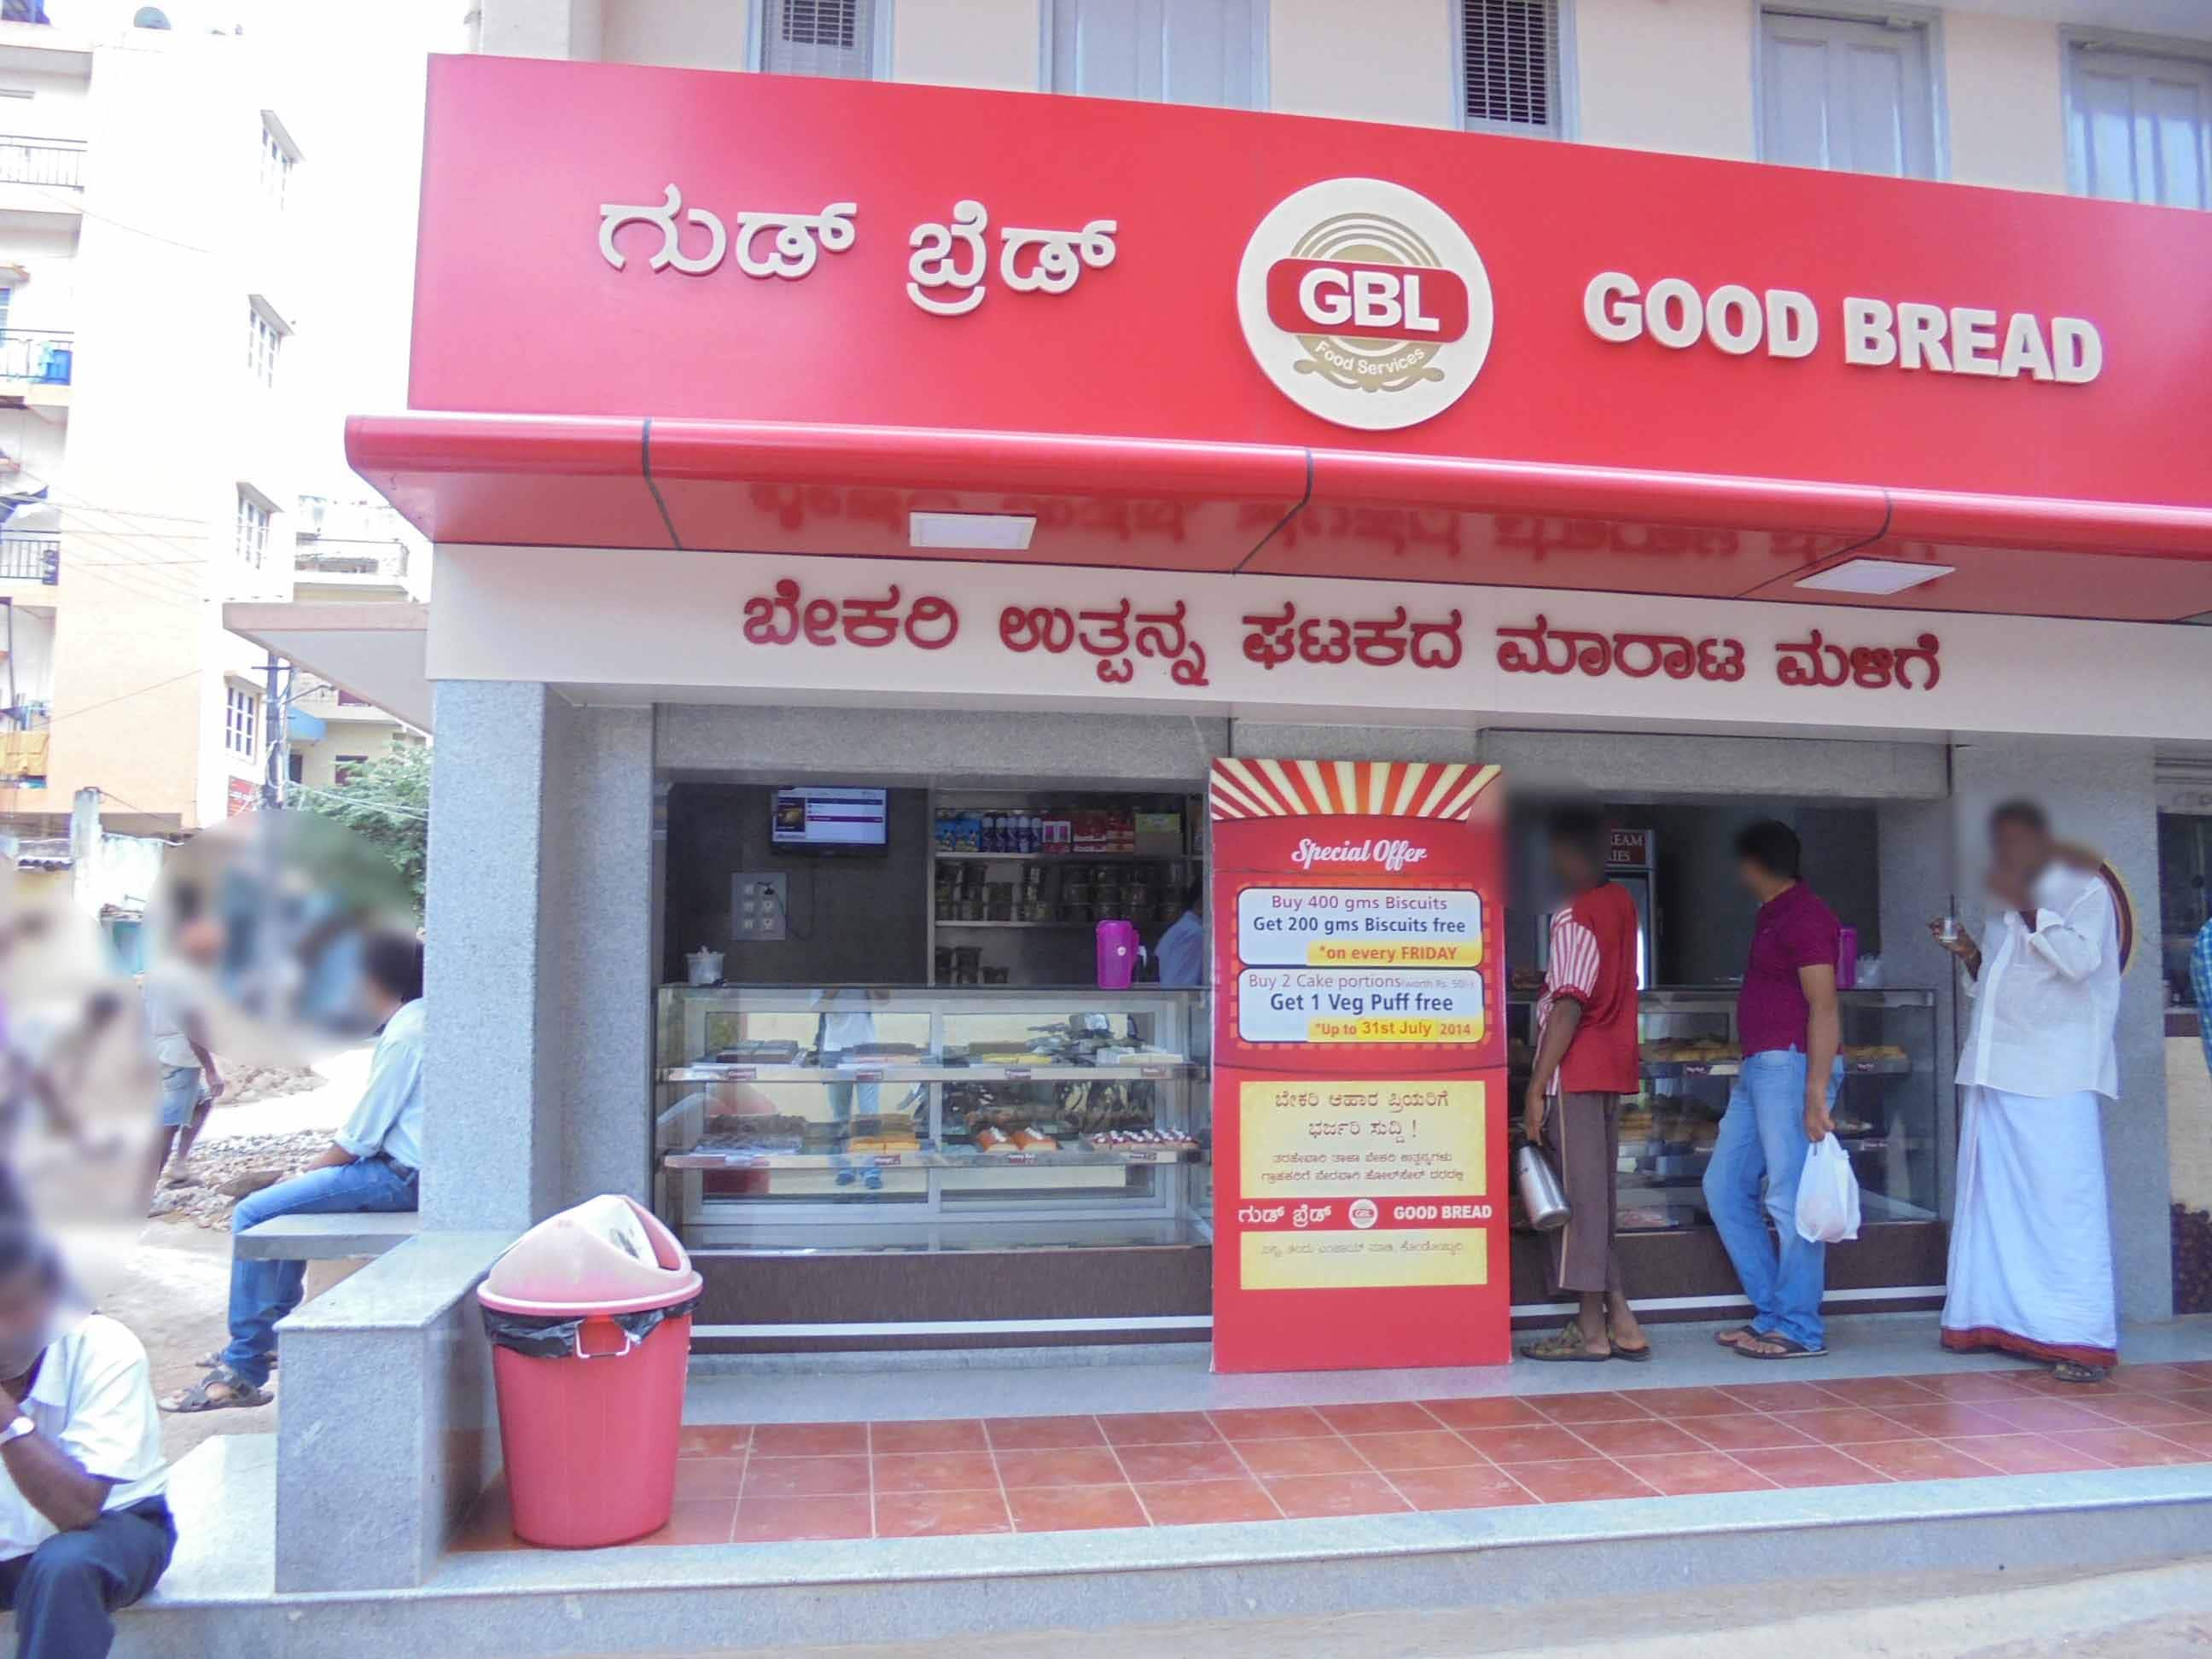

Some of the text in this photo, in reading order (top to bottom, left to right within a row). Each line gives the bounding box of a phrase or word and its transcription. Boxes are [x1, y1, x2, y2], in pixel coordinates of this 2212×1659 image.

[599, 183, 1118, 317] ಗುಡ್ ಬ್ರೆಡ್
[1298, 267, 1441, 333] GBL
[1583, 271, 2104, 384] GOOD BREAD
[1314, 341, 1426, 375] Food Services
[742, 578, 1941, 691] ಬೇಕರಿ ಉತ್ಪನ್ನ ಘಟಕದ ಮಾರಾಟ ಮಳಿಗೆ
[1610, 834, 1644, 847] EAM
[1291, 838, 1428, 871] Special Offer
[1272, 895, 1448, 912] Buy 400 gms Biscuits
[1253, 917, 1466, 934] Get 200 gms Biscuits free
[1351, 947, 1397, 963] every
[1401, 947, 1458, 960] FRIDAY
[1249, 975, 1278, 991] Buy
[1283, 975, 1291, 988] 2
[1296, 975, 1333, 988] Cake
[1338, 975, 1401, 991] portions
[1270, 992, 1453, 1015] Get 1 Veg Puff free
[1342, 1022, 1357, 1035] to
[1362, 1020, 1396, 1034] 31st
[1399, 1020, 1433, 1038] July
[1439, 1023, 1471, 1035] 2014
[1275, 1091, 1319, 1107] ಬೇಕರಿ
[1329, 1092, 1379, 1107] ಆಹಾರ
[1238, 1204, 1332, 1228] ಗುಡ್ ಬ್ರೆಡ್
[1394, 1204, 1493, 1220] GOOD BREAD
